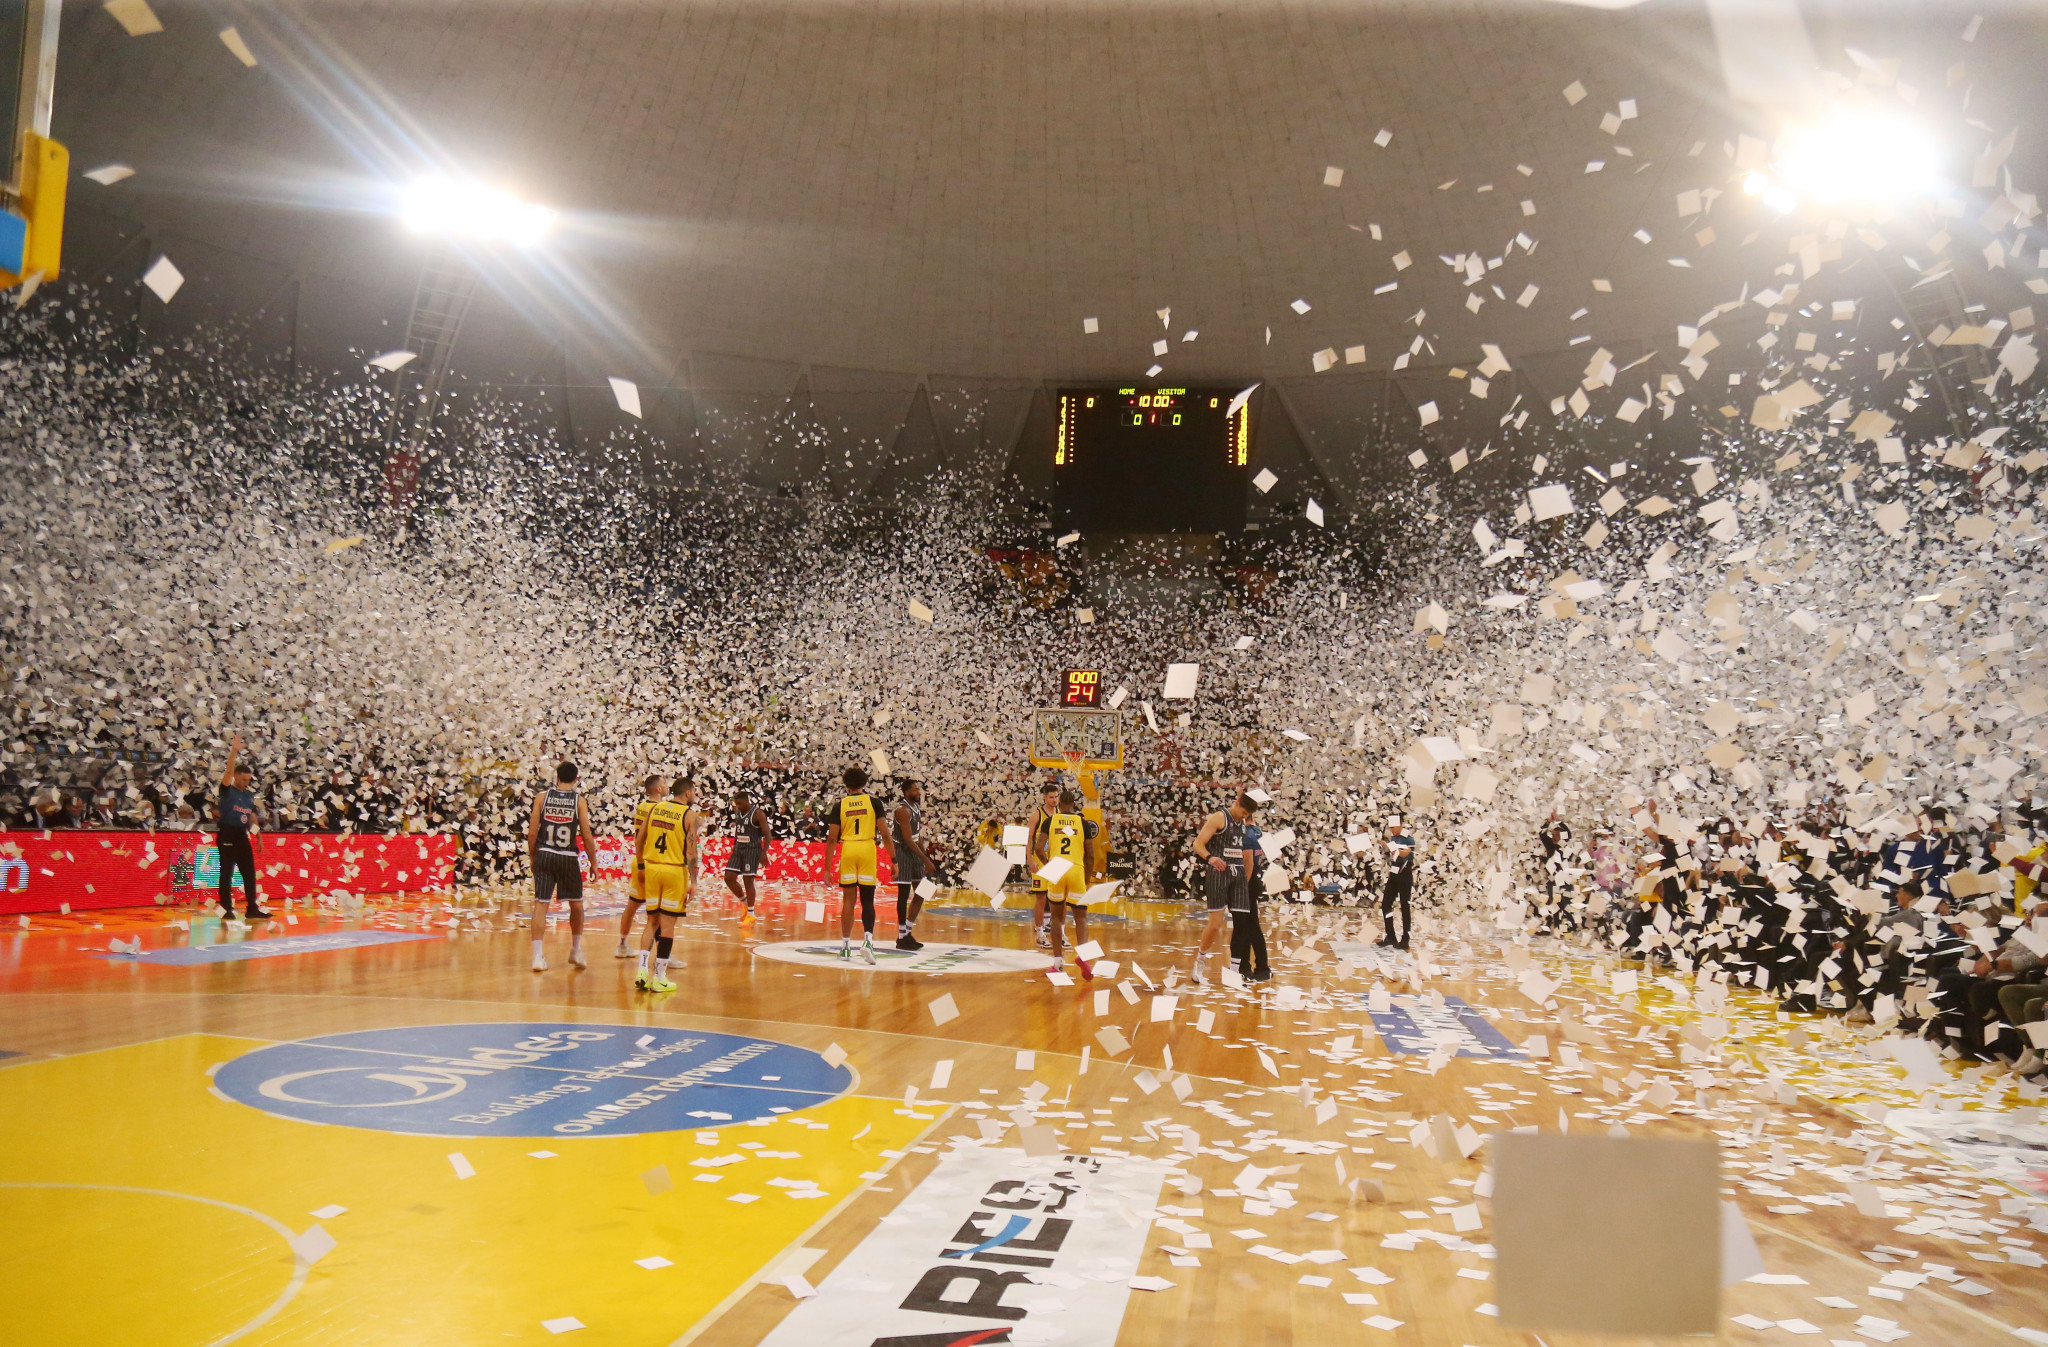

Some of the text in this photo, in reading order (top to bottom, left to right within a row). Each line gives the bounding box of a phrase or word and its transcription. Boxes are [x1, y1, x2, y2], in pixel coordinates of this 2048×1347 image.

[1157, 388, 1186, 396] VISITOR
[1086, 397, 1094, 408] 0
[1210, 397, 1219, 408] 0
[1133, 413, 1143, 426] 0
[1151, 413, 1156, 424] 1
[1172, 413, 1182, 426] 0
[1069, 671, 1098, 684] 10:00
[1067, 685, 1094, 702] 24
[545, 807, 574, 816] KRAFT
[736, 824, 745, 834] 24
[854, 818, 860, 835] 1
[545, 824, 571, 848] 19
[654, 832, 668, 855] 4
[1060, 837, 1071, 855] 2
[449, 1083, 593, 1125] Building
